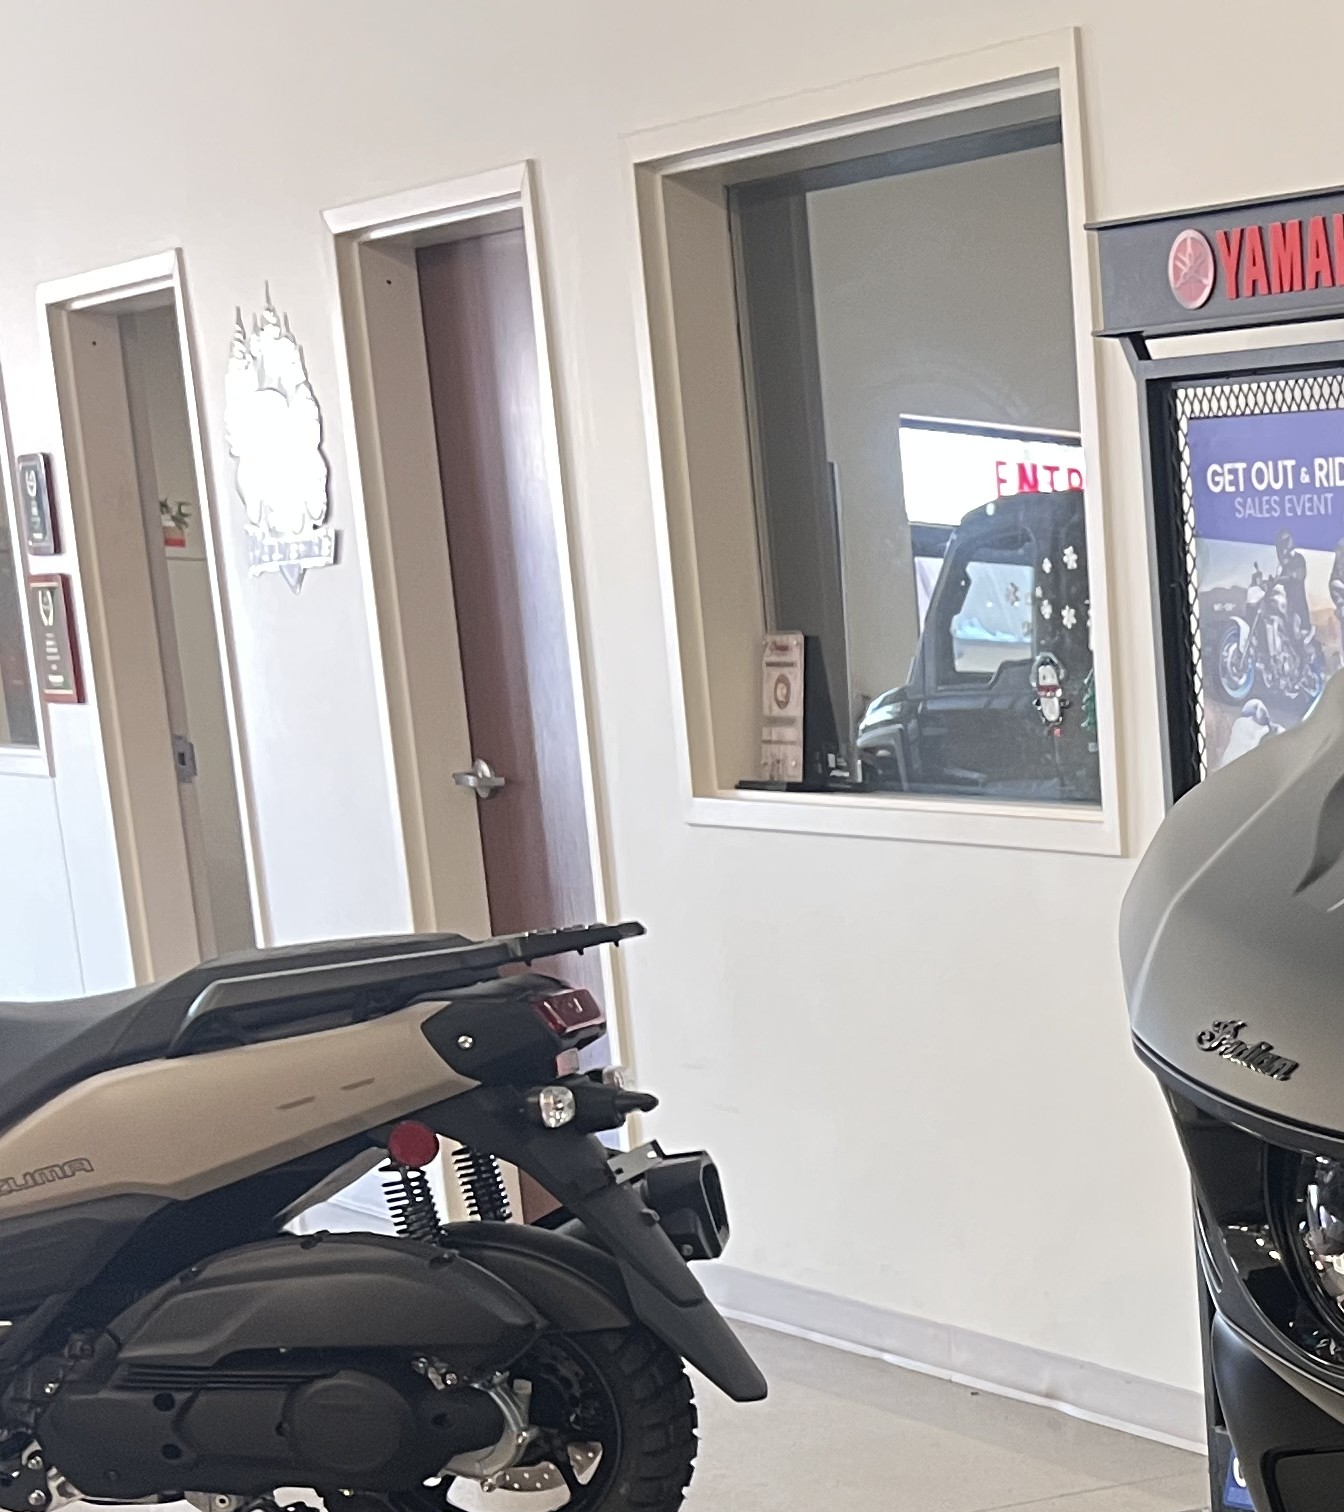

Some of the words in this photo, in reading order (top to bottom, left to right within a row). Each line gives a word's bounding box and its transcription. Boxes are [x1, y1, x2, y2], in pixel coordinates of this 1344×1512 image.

[1206, 462, 1247, 493] GET
[1251, 459, 1296, 491] OUT
[1300, 467, 1310, 483] &
[1234, 495, 1281, 519] SALES
[1284, 493, 1334, 517] EVENT
